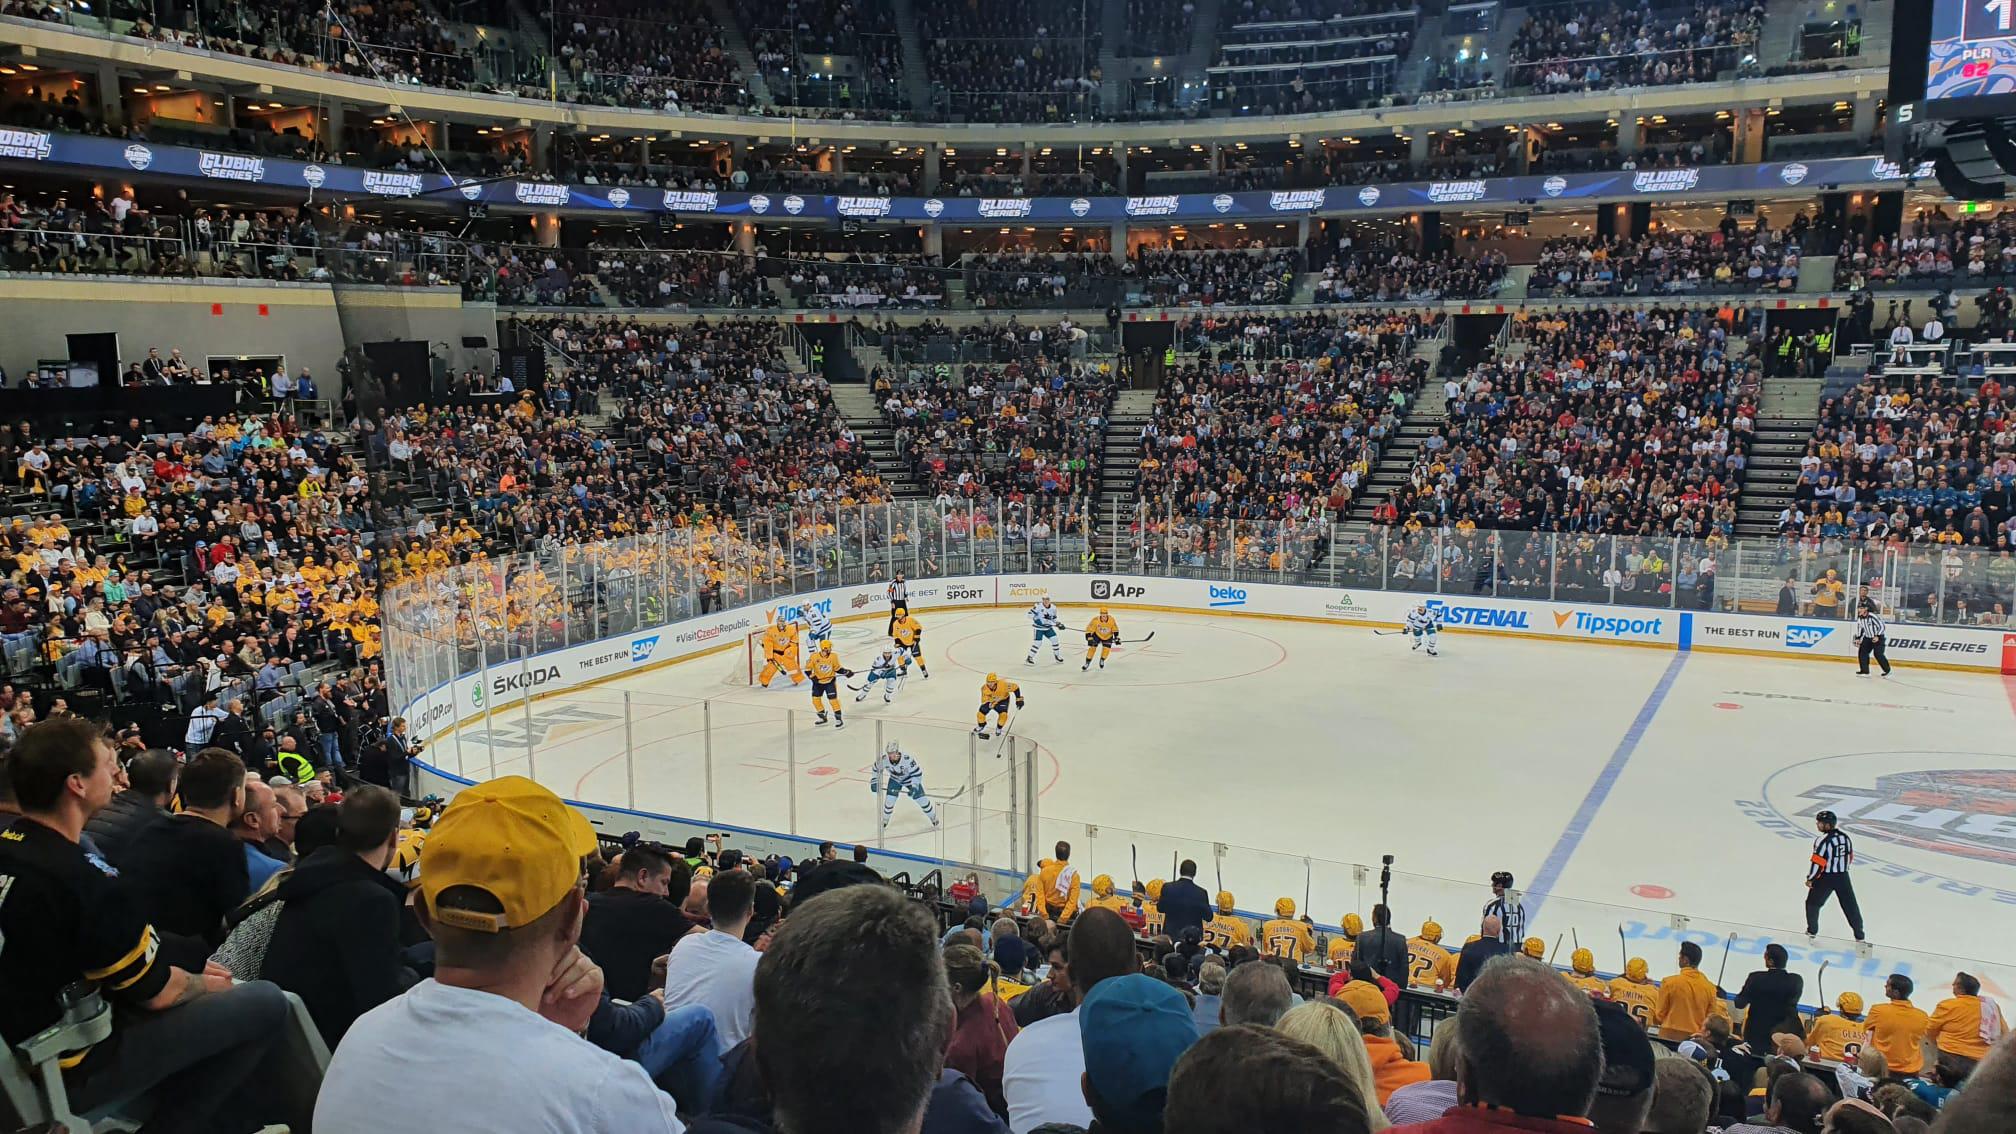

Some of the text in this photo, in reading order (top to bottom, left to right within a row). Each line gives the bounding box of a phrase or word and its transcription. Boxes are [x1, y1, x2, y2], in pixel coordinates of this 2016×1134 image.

[1984, 0, 2011, 30] 1
[201, 153, 263, 173] GLOBAL
[211, 168, 252, 180] SERIES
[365, 171, 421, 189] GLOBAL
[1636, 168, 1699, 186] GLOBAL
[373, 184, 410, 195] SERIES
[520, 182, 569, 198] GLOBAL
[1430, 180, 1486, 195] GLOBAL
[1644, 182, 1684, 192] SERIES
[525, 195, 559, 204] SERIES
[666, 191, 717, 205] GLOBAL
[1273, 189, 1325, 202] GLOBAL
[1438, 193, 1473, 202] SERIES
[673, 203, 706, 211] SERIES
[840, 197, 891, 209] GLOBAL
[981, 199, 1032, 211] GLOBAL
[1128, 196, 1179, 209] GLOBAL
[1280, 201, 1314, 210] SERIES
[847, 208, 880, 216] SERIES
[1134, 207, 1168, 216] SERIES
[918, 589, 939, 597] BEST
[946, 590, 984, 600] SPORT
[1009, 588, 1048, 597] ACTION
[1209, 585, 1247, 600] beko
[675, 618, 750, 643] #VisitCzechRepublic
[1575, 612, 1662, 636] Tipsport
[1704, 626, 1823, 644] THE BEST RUN SAP
[580, 641, 654, 669] THE BEST RUN SAP
[493, 665, 561, 696] ŠKODA
[1506, 913, 1519, 927] 70
[1269, 935, 1297, 959] 57
[1622, 990, 1643, 1001] SMITH
